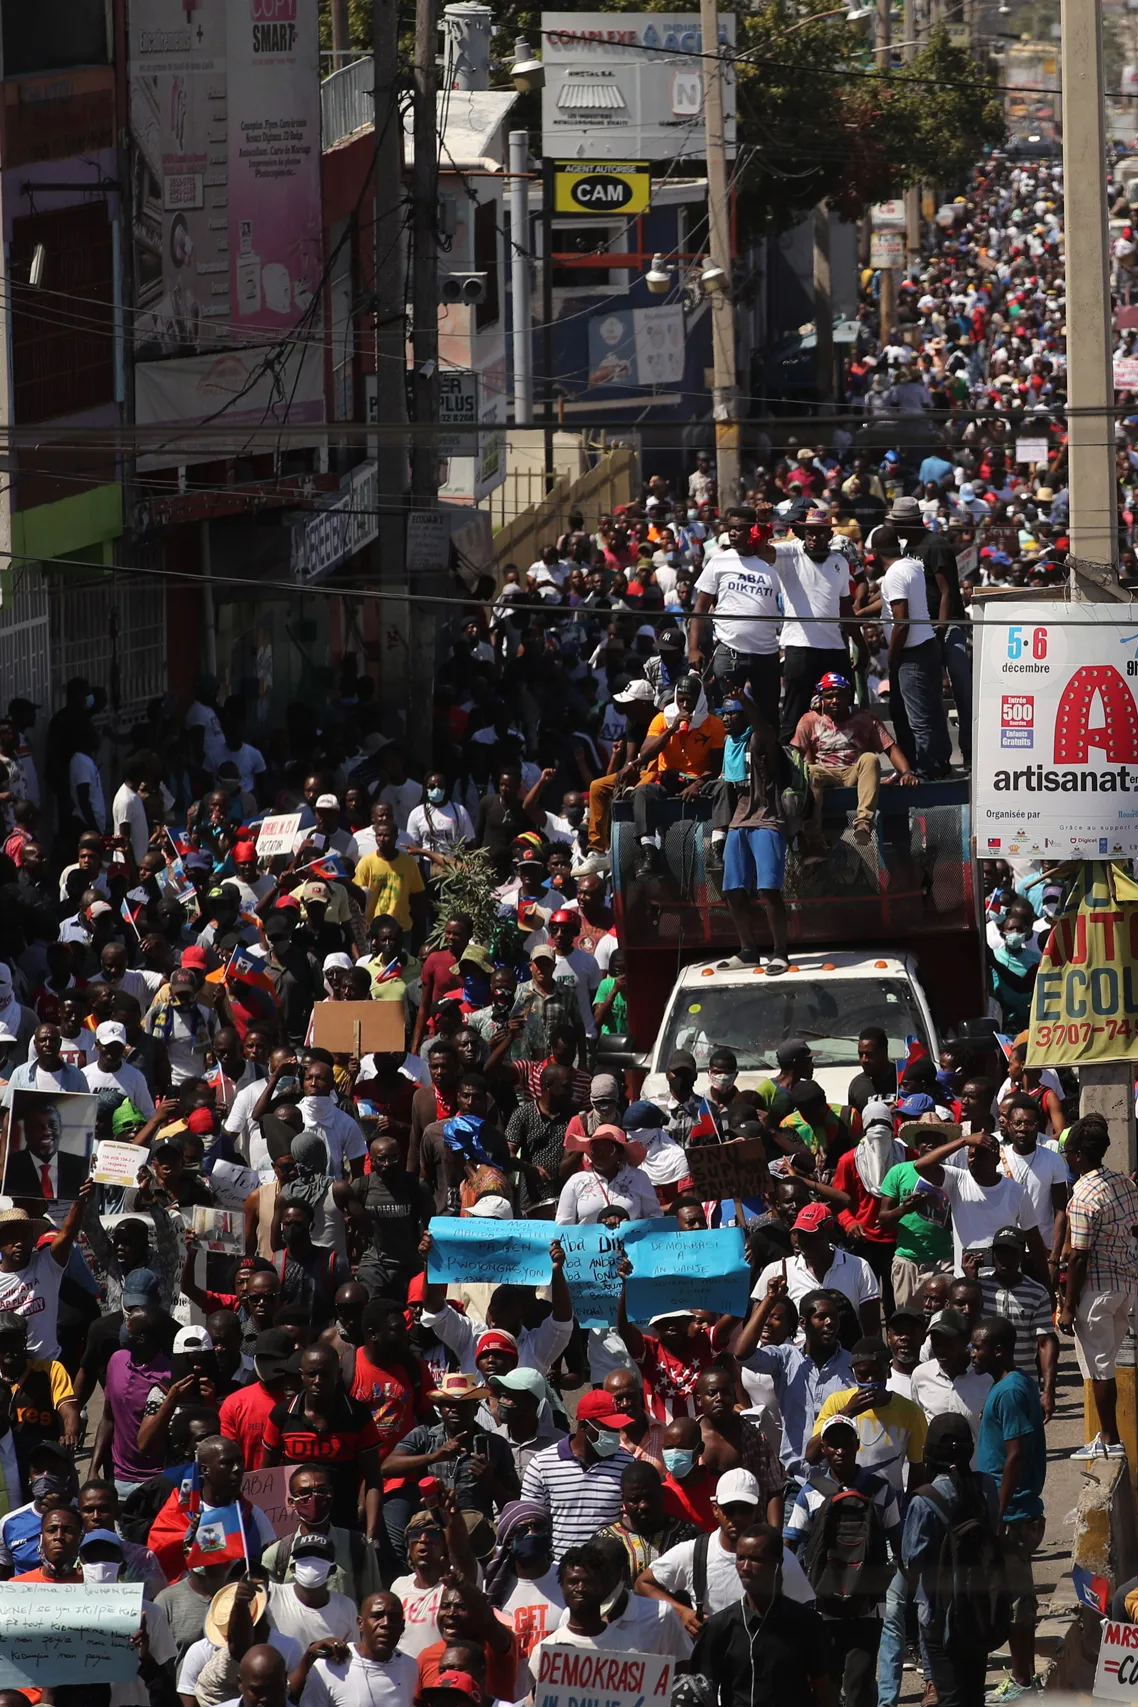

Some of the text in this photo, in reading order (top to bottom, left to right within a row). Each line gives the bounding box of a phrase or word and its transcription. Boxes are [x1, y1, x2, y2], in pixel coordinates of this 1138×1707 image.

[253, 23, 293, 53] SMART
[545, 29, 636, 46] COMPLEXE
[677, 83, 697, 105] N
[565, 165, 593, 173] AGENT
[576, 184, 624, 202] CAM
[737, 573, 766, 585] ABA
[727, 581, 773, 597] DIKTATI
[1007, 626, 1048, 660] 5 6
[1002, 662, 1050, 674] décembre
[1008, 696, 1027, 704] Entrée
[1002, 703, 1033, 721] 500
[1002, 737, 1031, 746] Gratuits
[993, 764, 1131, 792] artisanat
[986, 808, 1041, 820] Organisée par
[1100, 824, 1131, 832] support
[502, 1243, 532, 1252] GEN
[677, 1250, 684, 1260] A
[299, 1535, 327, 1545] NYPD
[514, 1604, 549, 1633] GET
[538, 1650, 670, 1697] DEMOKRASI A
